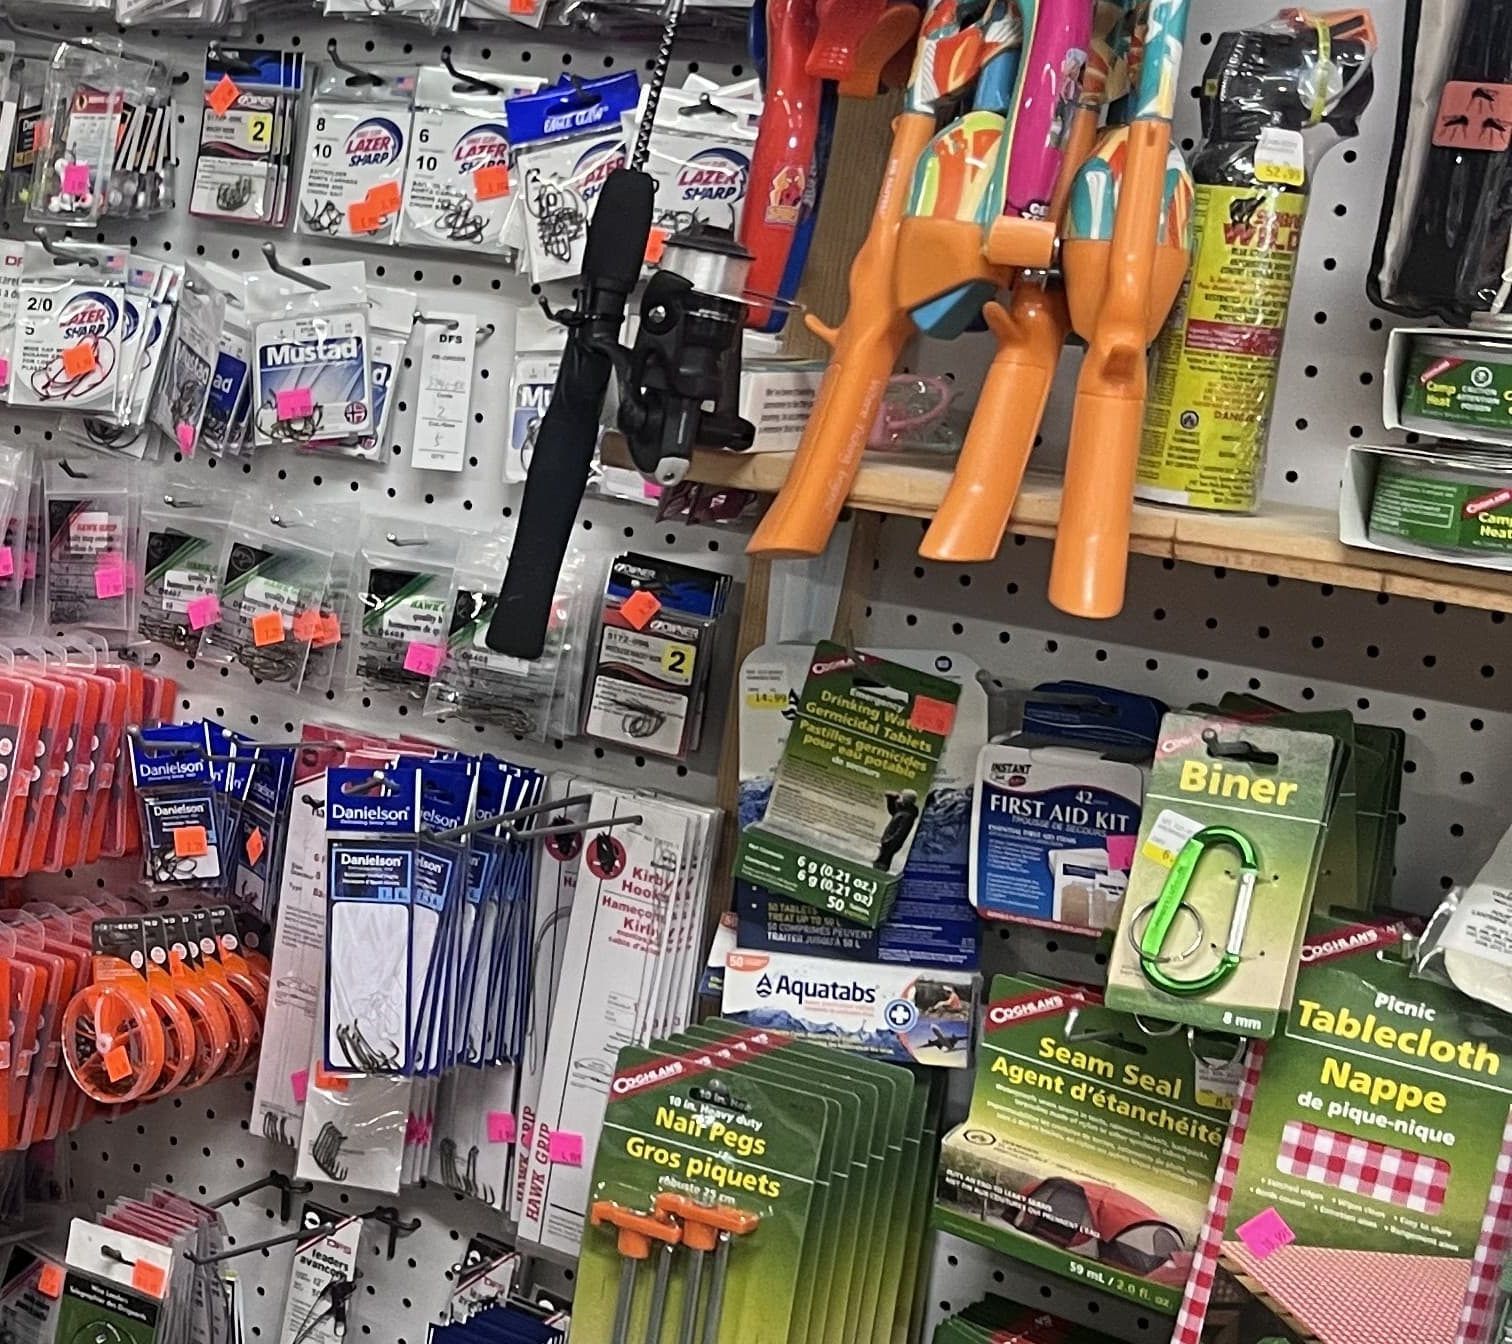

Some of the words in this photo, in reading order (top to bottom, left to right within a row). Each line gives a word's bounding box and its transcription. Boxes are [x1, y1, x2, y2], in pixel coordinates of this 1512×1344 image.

[316, 117, 326, 132] 8
[345, 134, 392, 157] LAZER
[349, 150, 389, 167] SHARP
[677, 169, 739, 188] LAZER
[682, 186, 738, 203] SHARP
[27, 295, 53, 312] 2/0
[439, 333, 463, 345] DFS
[266, 338, 361, 366] Mustad
[1426, 381, 1456, 395] Camp
[805, 702, 880, 732] Germicidal
[883, 727, 932, 753] Tablets
[799, 720, 858, 750] Pastilles
[861, 741, 929, 773] germicides
[802, 733, 836, 754] pour
[838, 745, 860, 762] eau
[863, 751, 917, 778] potable
[140, 759, 206, 777] Danielson
[991, 763, 1032, 775] INSTANT
[1178, 759, 1298, 806] Biner
[1074, 790, 1094, 805] 42
[332, 803, 410, 822] Danielson
[989, 792, 1044, 818] FIRST
[1048, 802, 1091, 826] AID
[1095, 809, 1130, 832] KIT
[341, 854, 402, 867] Danielson
[797, 856, 807, 867] 6
[808, 862, 817, 873] g
[820, 864, 851, 883] (0.21
[853, 878, 877, 894] oz.)
[827, 896, 845, 911] 50
[729, 956, 744, 968] 50
[775, 974, 876, 1004] Aquatabs
[1375, 992, 1437, 1022] Picnic
[1223, 1011, 1232, 1024] 8
[1234, 1016, 1263, 1030] mm
[1297, 1000, 1502, 1075] Tablecloth
[613, 1060, 684, 1094] COGHLAN'S
[1038, 1036, 1117, 1079] Seam
[1122, 1063, 1184, 1101] Seal
[1319, 1057, 1449, 1115] Nappe
[990, 1057, 1066, 1096] Agent
[1068, 1081, 1225, 1149] d'étanchéité
[654, 1106, 706, 1140] Nail
[709, 1122, 766, 1156] Pegs
[1297, 1091, 1326, 1111] de
[1327, 1098, 1457, 1147] pique-nique
[625, 1136, 681, 1169] Gros
[686, 1154, 781, 1198] piquets
[312, 1249, 349, 1271] leaders
